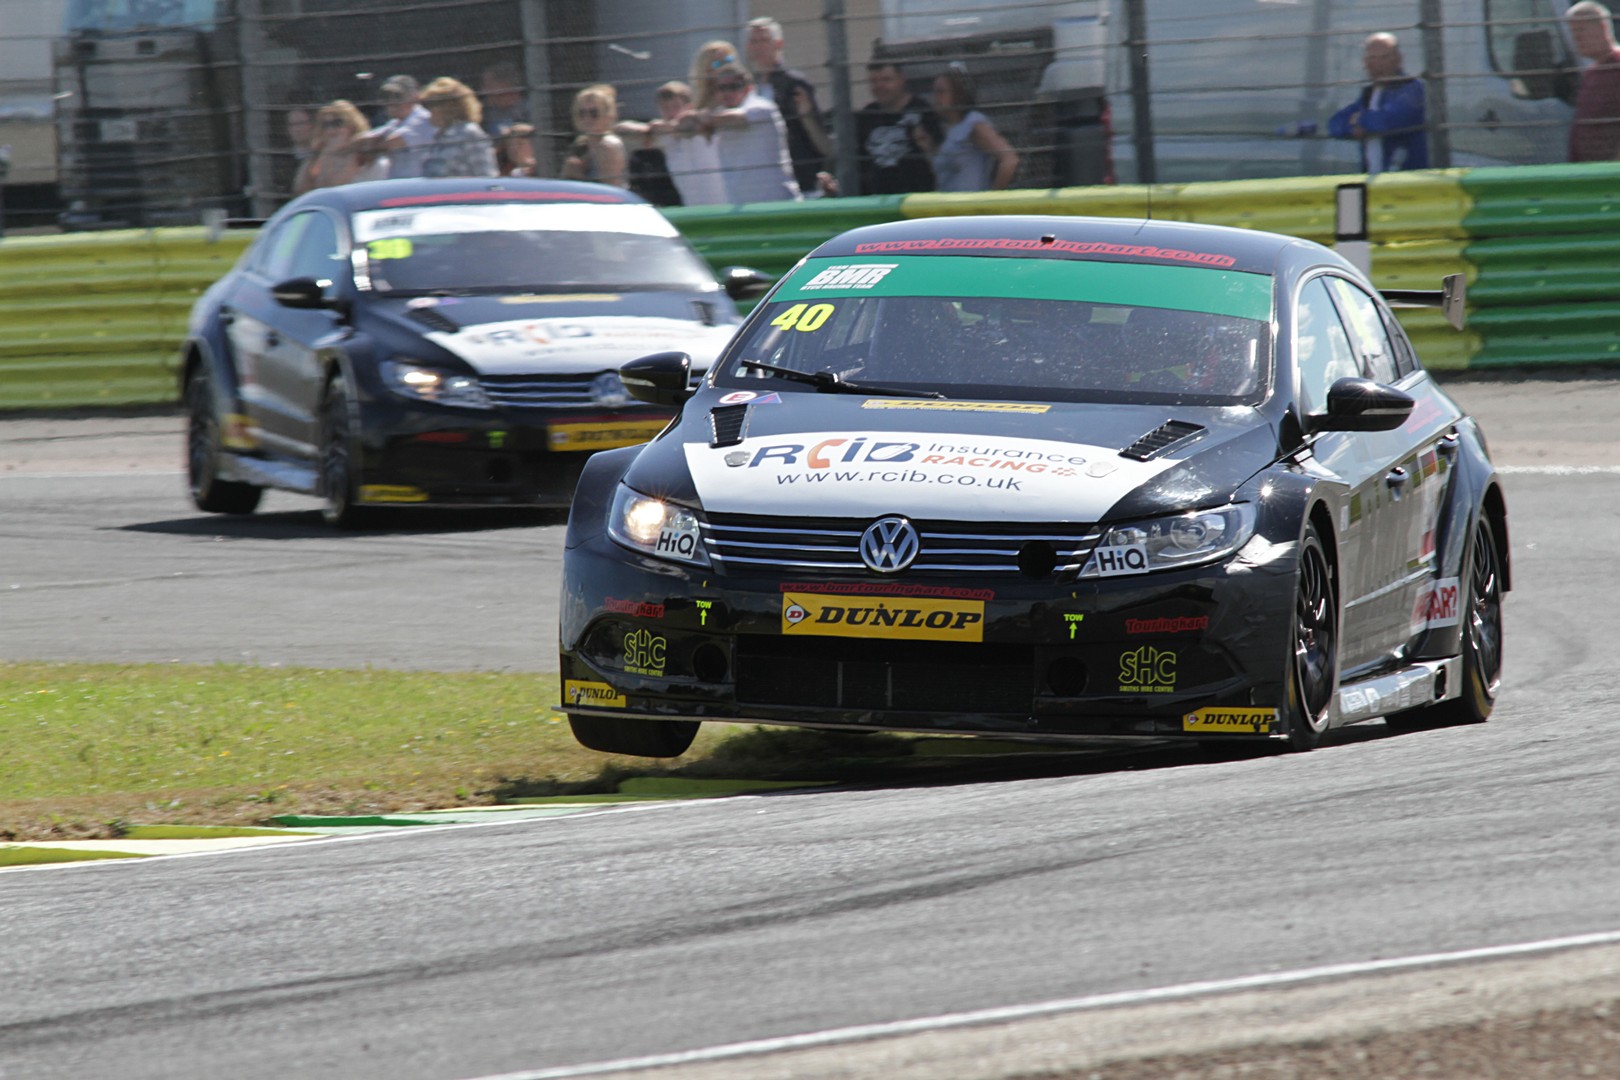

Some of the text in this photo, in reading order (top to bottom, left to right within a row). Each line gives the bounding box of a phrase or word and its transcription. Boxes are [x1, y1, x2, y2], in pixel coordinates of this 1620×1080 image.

[806, 268, 892, 286] BMR
[770, 303, 835, 332] 40
[920, 455, 1048, 473] RACING
[929, 443, 1087, 465] Insurance
[777, 470, 1022, 491] www.rcib.co.uk
[657, 531, 695, 556] HiQ
[1098, 549, 1146, 572] HiQ
[781, 583, 993, 599] www.bmrtouringkart.co.uk
[696, 600, 712, 609] TOW
[815, 606, 982, 629] DUNLOP
[1064, 614, 1084, 622] TOW
[1126, 616, 1208, 633] Touringkart
[624, 629, 666, 668] SHC
[1118, 645, 1176, 684] SHC
[1203, 713, 1276, 726] DUNLOP
